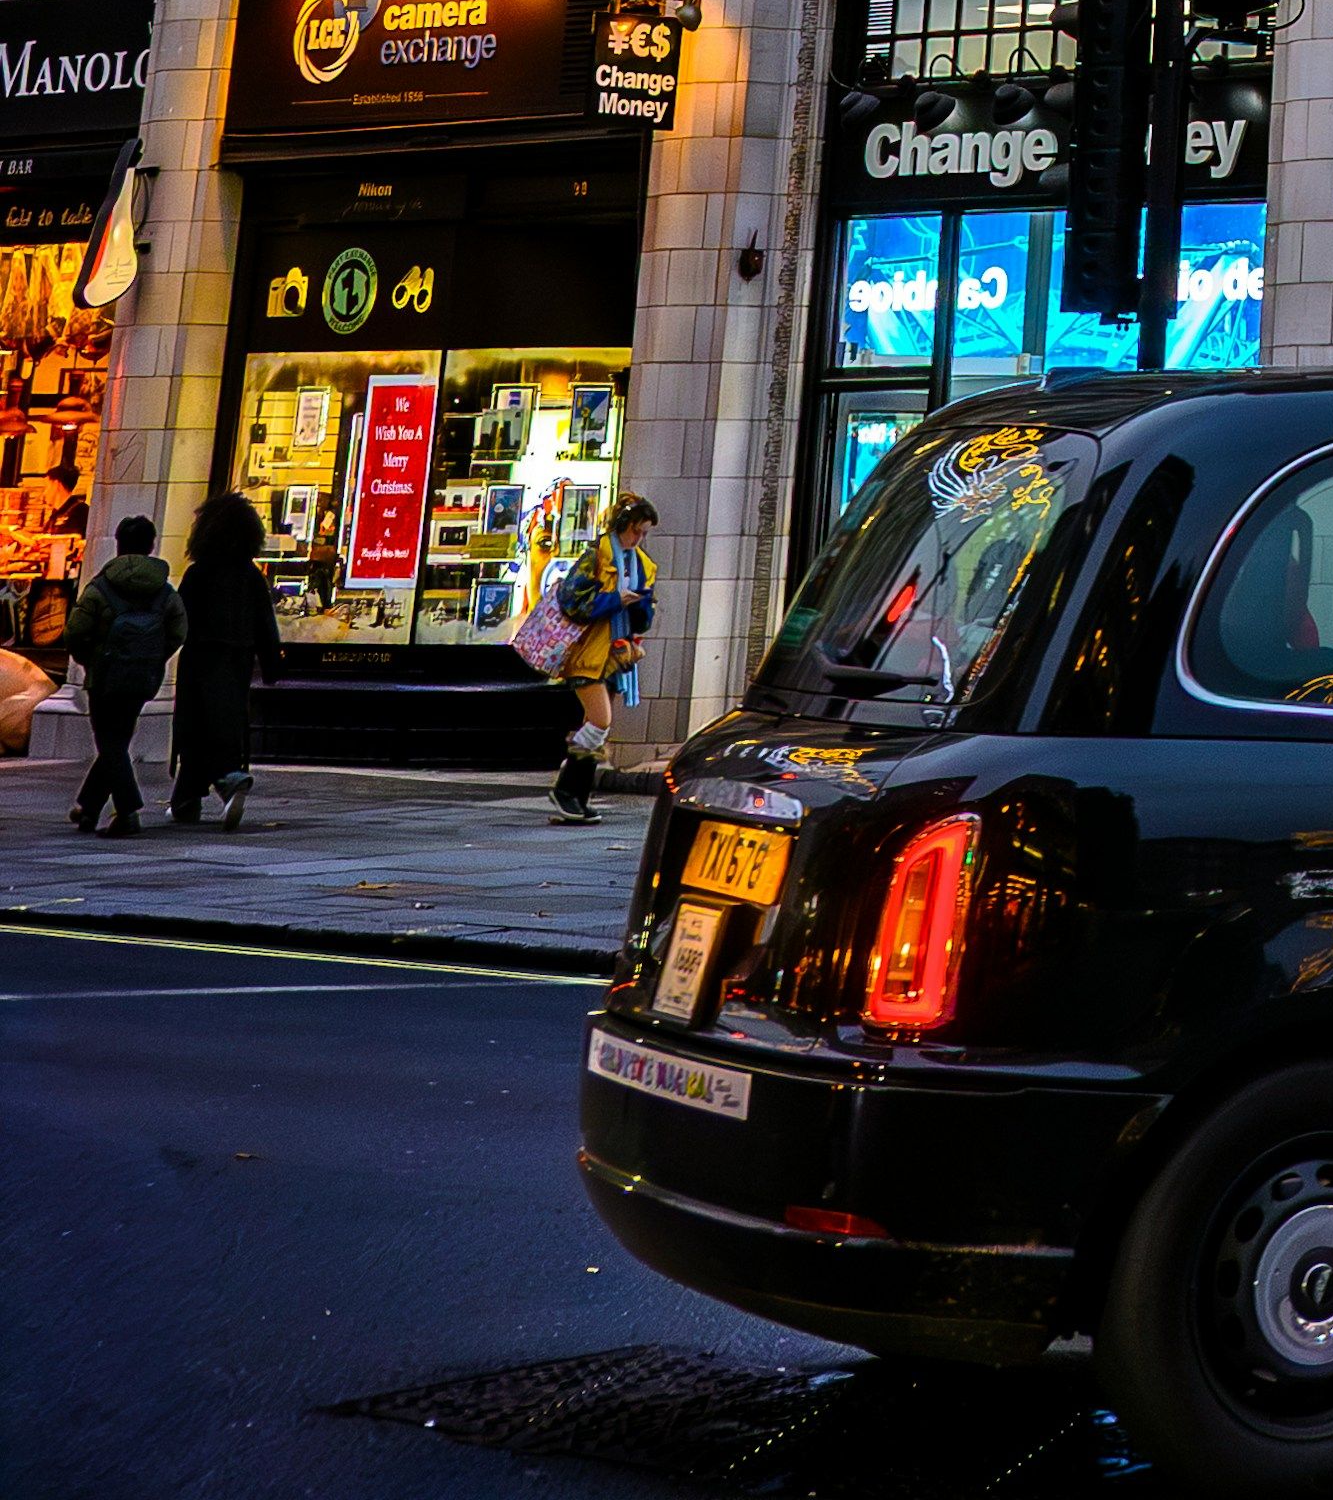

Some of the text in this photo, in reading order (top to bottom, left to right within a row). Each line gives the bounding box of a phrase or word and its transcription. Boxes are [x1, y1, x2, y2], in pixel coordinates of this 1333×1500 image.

[306, 18, 347, 51] LCE
[380, 30, 497, 69] exchange
[595, 64, 676, 96] Change
[597, 92, 669, 123] Money
[7, 159, 33, 175] BAR
[864, 121, 1058, 188] Change
[358, 182, 393, 197] Nikon
[395, 397, 410, 413] We
[375, 425, 423, 441] Wish You A
[382, 452, 410, 473] Merry
